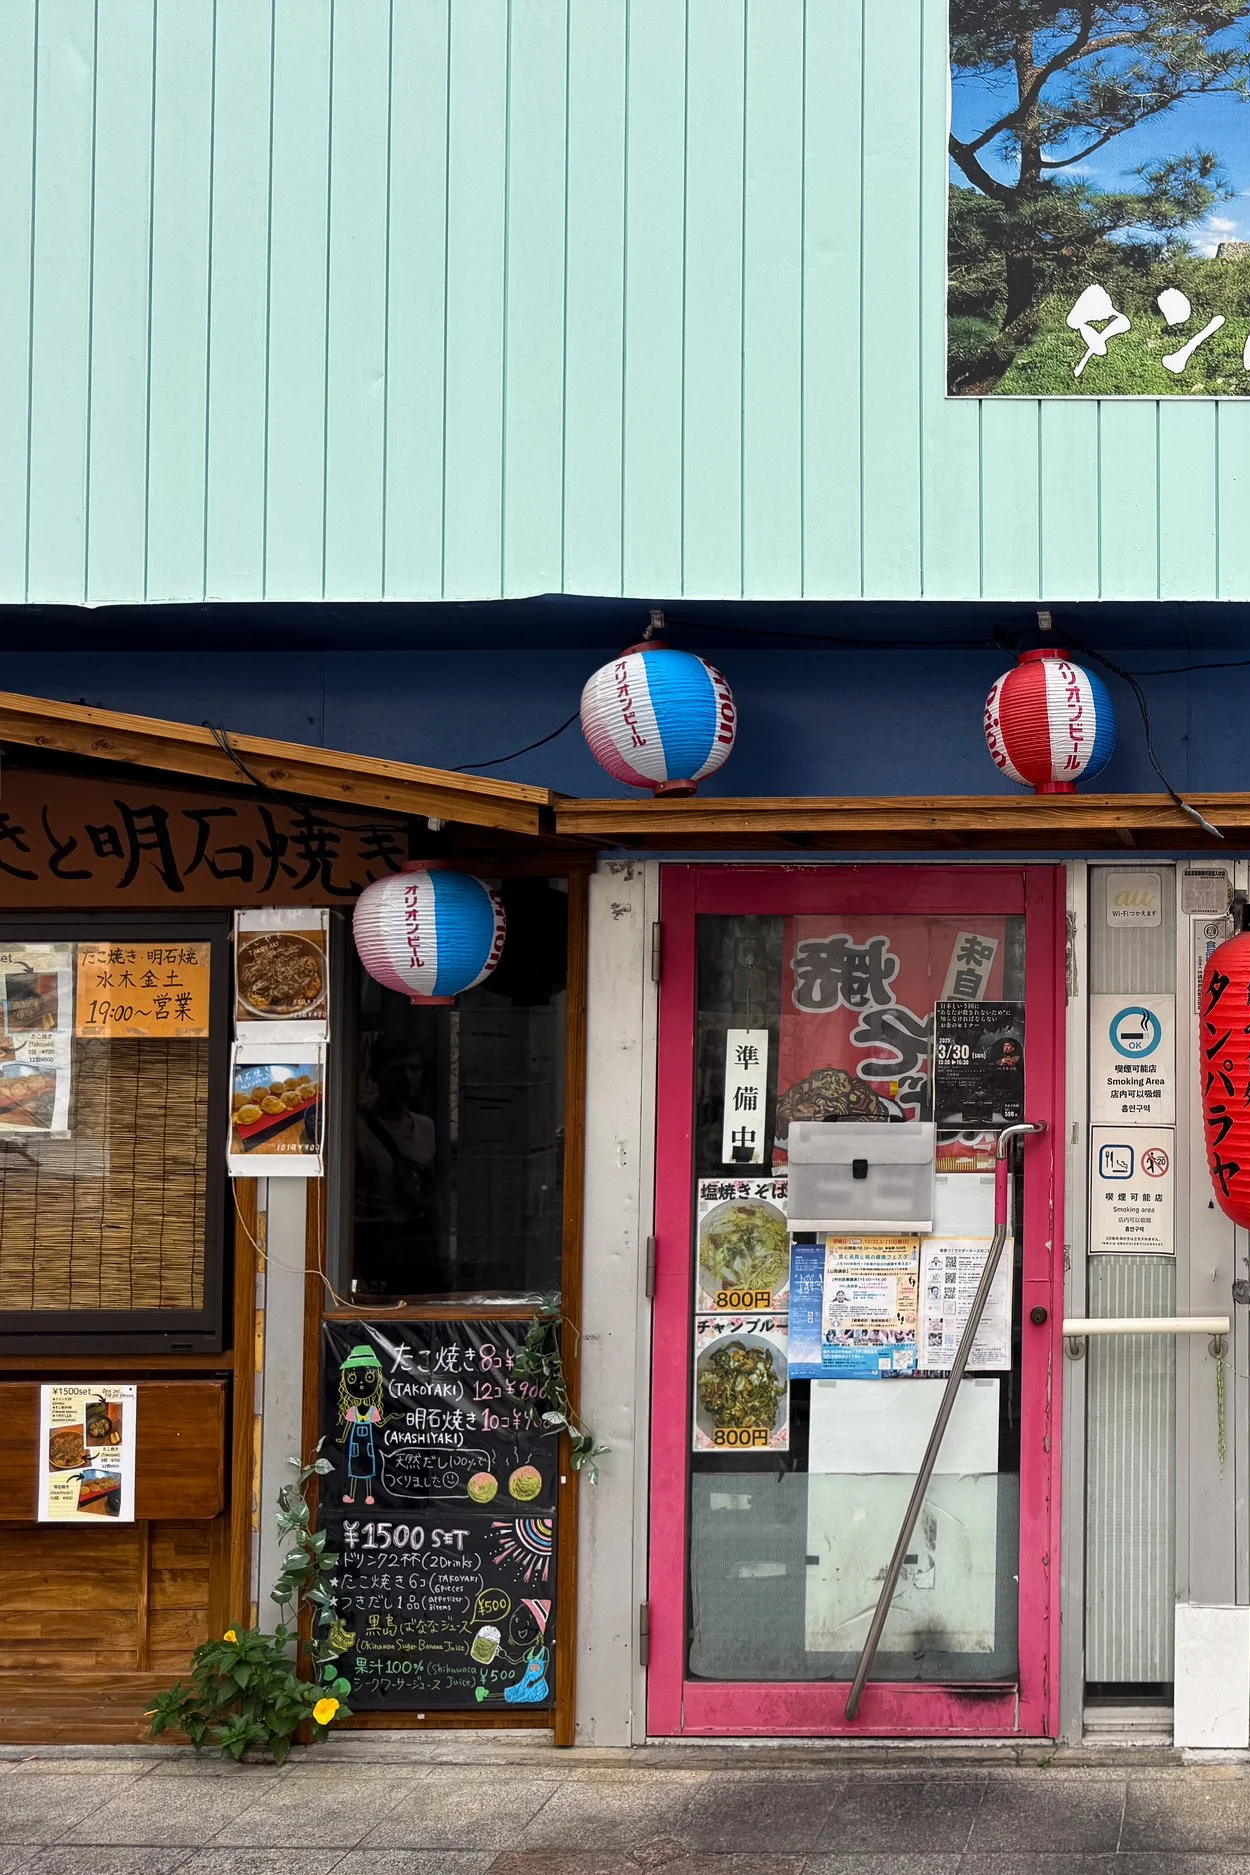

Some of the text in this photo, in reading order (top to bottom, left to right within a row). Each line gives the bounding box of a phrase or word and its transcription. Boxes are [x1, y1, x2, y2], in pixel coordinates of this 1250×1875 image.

[615, 661, 647, 748] オリオンビール
[1058, 662, 1083, 770] オリオンビール
[1115, 890, 1154, 907] au
[404, 885, 425, 968] オリオンビール
[97, 970, 184, 988] 水木金土
[938, 1044, 970, 1059] 3/30
[1128, 1041, 1142, 1049] OK
[1114, 1064, 1157, 1073] 喫煙可能店
[1107, 1077, 1165, 1087] Smoking Area
[1204, 969, 1240, 1198] タンパラヤ
[731, 1045, 761, 1148] 準備中
[700, 1183, 788, 1200] 塩焼きそば
[1105, 1192, 1163, 1202] 喫煙可能店
[716, 1291, 771, 1308] 800円
[391, 1342, 477, 1373] たこ焼き
[388, 1378, 464, 1401] (TAKOYAKI)
[406, 1407, 477, 1431] 明石焼き
[384, 1430, 464, 1447] (AKASHIYAKI)
[714, 1429, 768, 1446] 800円
[386, 1474, 442, 1488] つくりました
[343, 1520, 470, 1551] ¥1500 SET
[478, 1599, 507, 1616] ¥500
[355, 1656, 424, 1675] 果汁100%
[480, 1667, 516, 1684] ¥500
